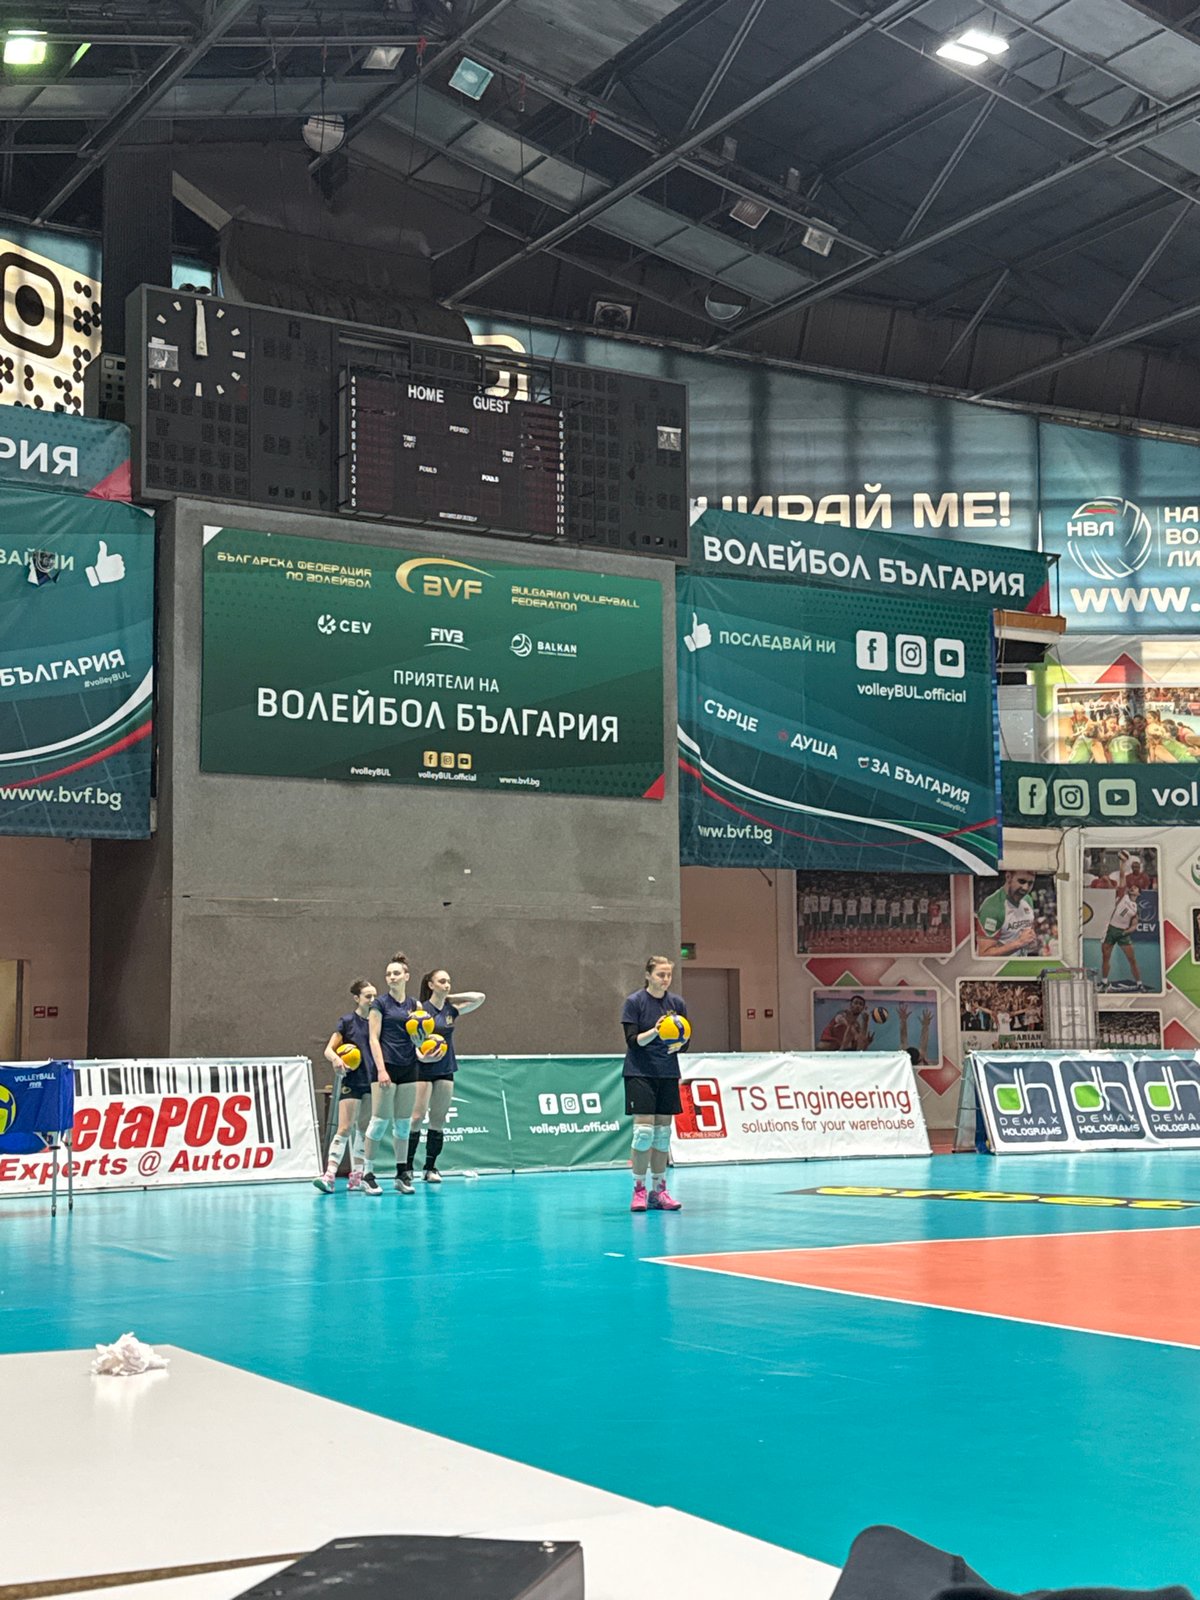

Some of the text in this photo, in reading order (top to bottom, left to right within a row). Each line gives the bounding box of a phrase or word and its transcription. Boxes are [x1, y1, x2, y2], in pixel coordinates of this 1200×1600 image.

[408, 385, 444, 403] HOME
[473, 396, 510, 414] GUEST
[913, 492, 1010, 528] МЕ!
[1067, 521, 1114, 537] НВЛ
[217, 551, 294, 569] БЪЛГАРСКА
[703, 535, 1025, 597] ВОЛЕЙБОЛ БЪЛГАРИЯ
[286, 571, 372, 589] ПО ВОЛЕЙБОЛ
[422, 575, 482, 600] BVF
[511, 585, 640, 608] BULGARIAN VOLLEYBALL
[511, 597, 578, 612] FEDERATION
[339, 620, 372, 635] CEV
[430, 628, 464, 644] FIVB
[537, 640, 577, 653] BALKAN
[719, 631, 836, 654] ПОСЛЕДВАЙ НИ
[0, 649, 125, 687] БЪЛГАРИЯ
[84, 671, 131, 688] #volleyBUL
[393, 670, 499, 693] ПРИЯТЕЛИ НА
[857, 683, 966, 703] volleyBUL.official
[257, 687, 618, 743] ВОЛЕЙБОЛ БЪЛГАРИЯ
[704, 699, 970, 804] СЪРЦЕ ДУША ЗА БЪЛГАРИЯ
[0, 786, 122, 810] www.bvf.bg
[1136, 923, 1156, 932] CEV
[14, 1072, 56, 1082] VOLLEYBALL
[731, 1085, 912, 1115] TS Engineering
[72, 1095, 253, 1153] etaPOS
[742, 1117, 915, 1134] solutions for your warehouse
[1000, 1116, 1060, 1126] DEMAX
[1077, 1114, 1136, 1123] DEMAX
[443, 1126, 489, 1134] OLLEYBALL
[529, 1121, 620, 1136] volleyBUL.official
[1002, 1126, 1062, 1136] HOLOGRAMS
[1079, 1123, 1140, 1134] HOLOGRAMS
[0, 1147, 274, 1185] Experts @ AutoID
